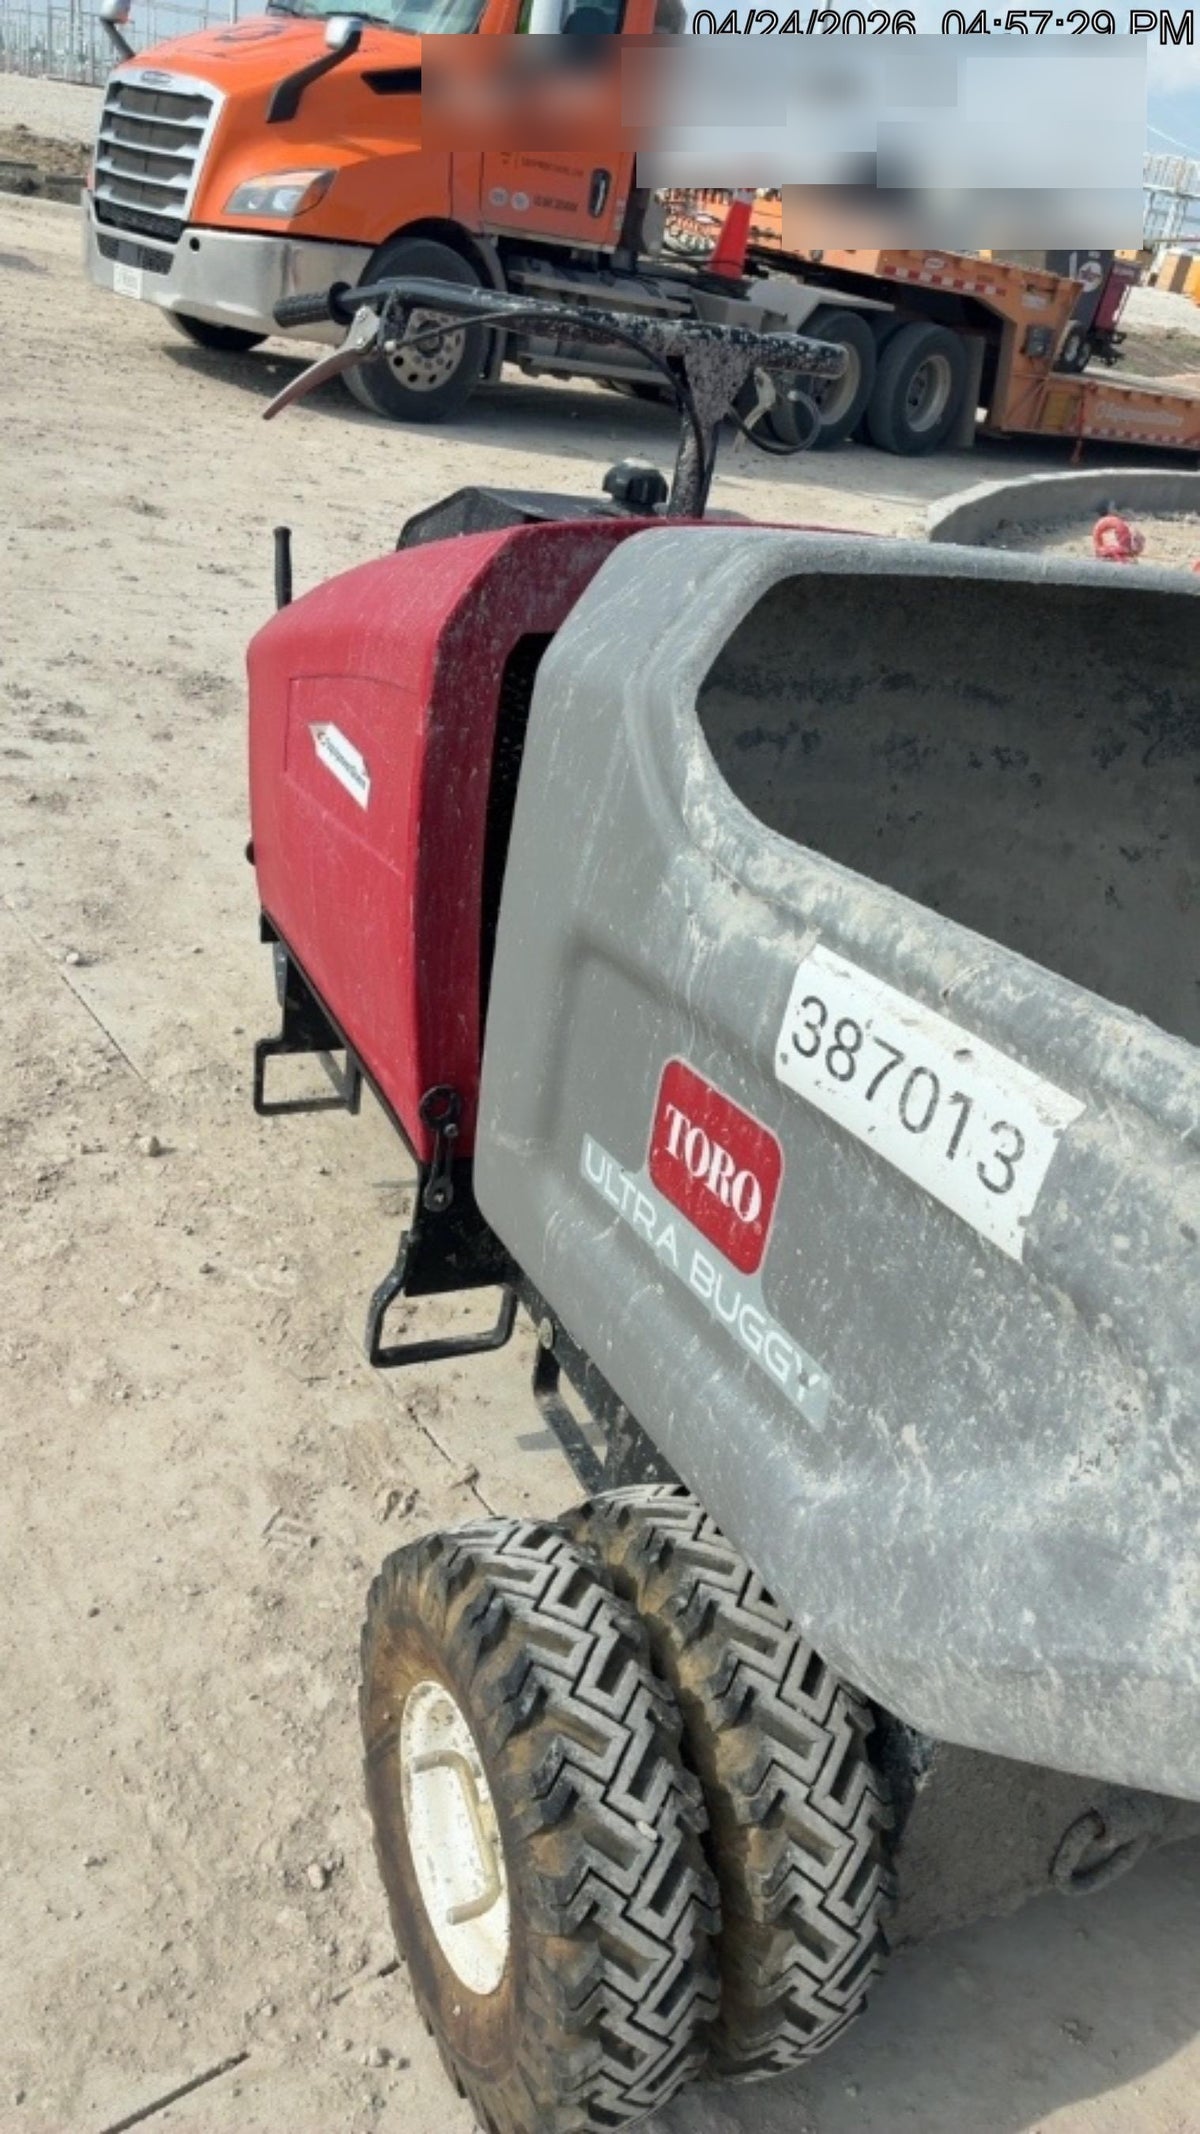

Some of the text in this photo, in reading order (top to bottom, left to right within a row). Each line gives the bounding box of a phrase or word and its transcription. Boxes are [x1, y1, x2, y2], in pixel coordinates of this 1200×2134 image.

[665, 1103, 763, 1223] TORO
[792, 995, 1025, 1194] 387013
[584, 1141, 821, 1401] ULTRA BUGGY
